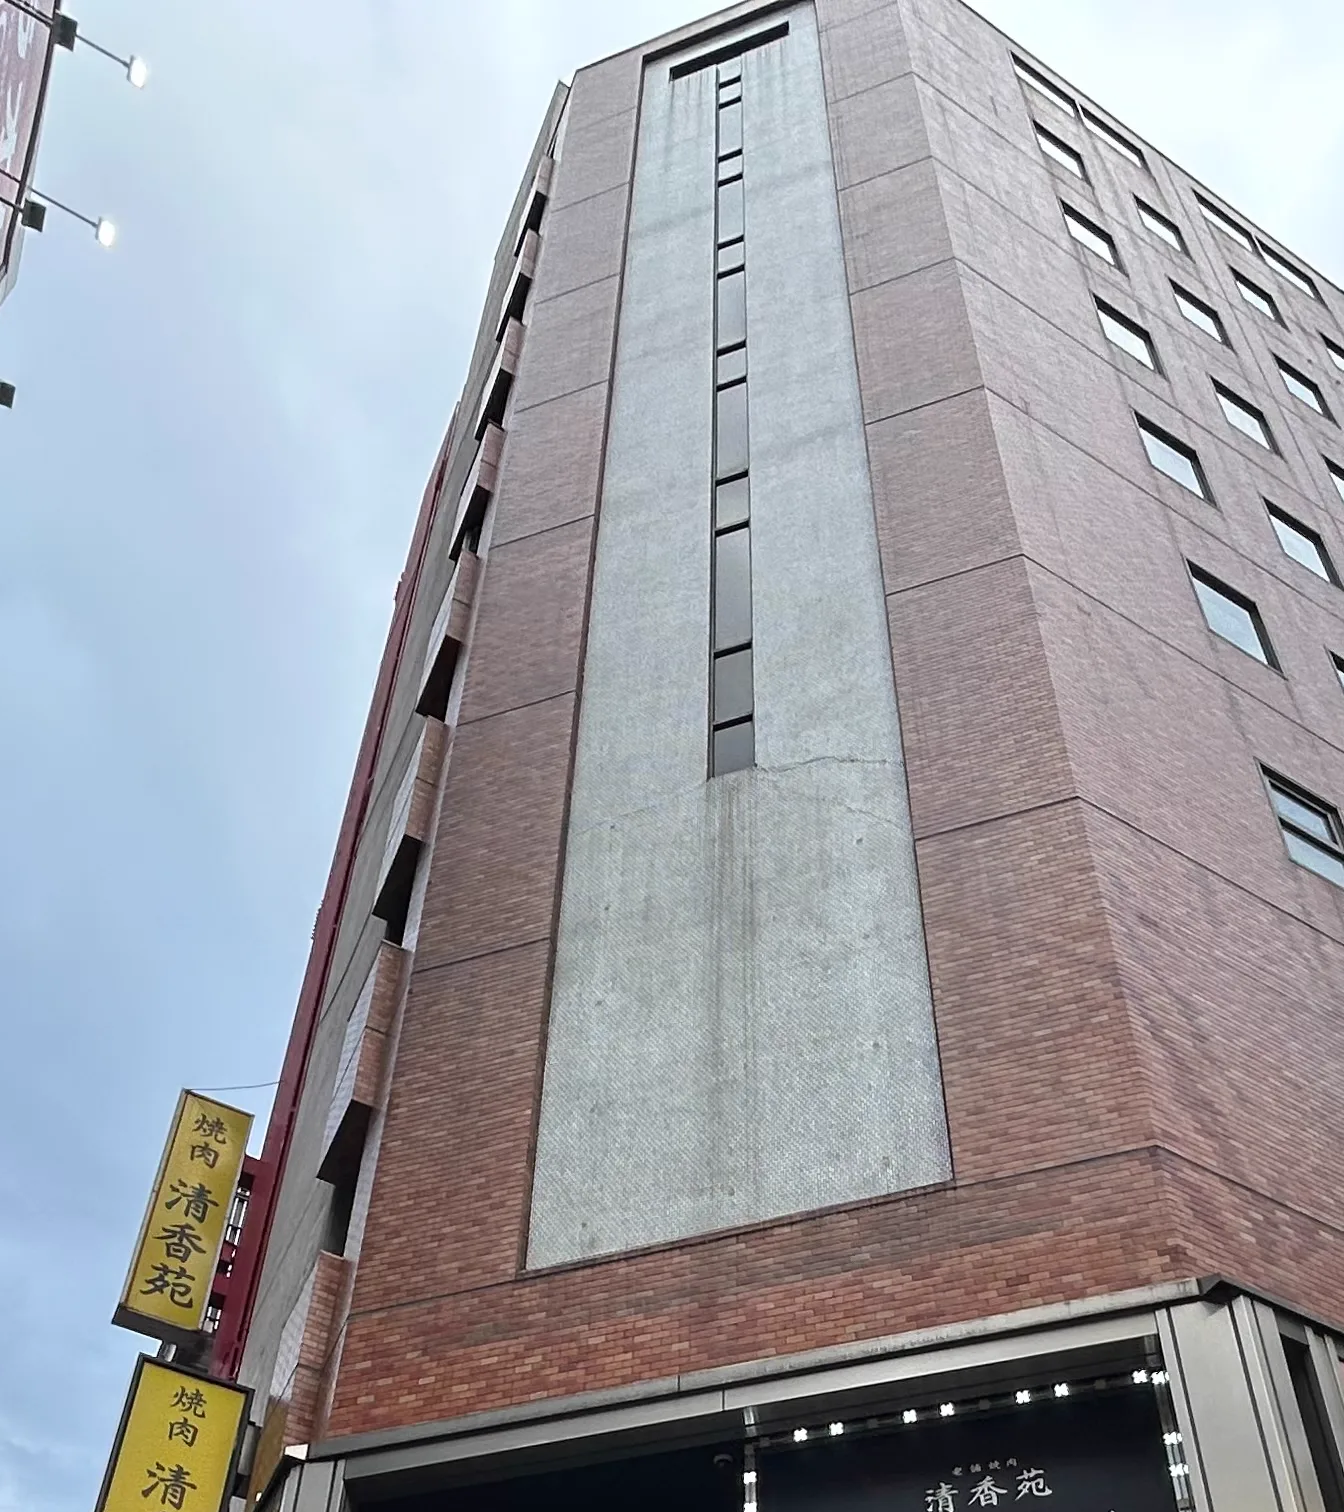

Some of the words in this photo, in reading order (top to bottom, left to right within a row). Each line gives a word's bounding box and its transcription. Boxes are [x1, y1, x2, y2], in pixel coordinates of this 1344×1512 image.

[190, 1112, 228, 1169] 焼肉
[140, 1178, 220, 1308] 清香苑
[169, 1386, 207, 1447] 焼肉
